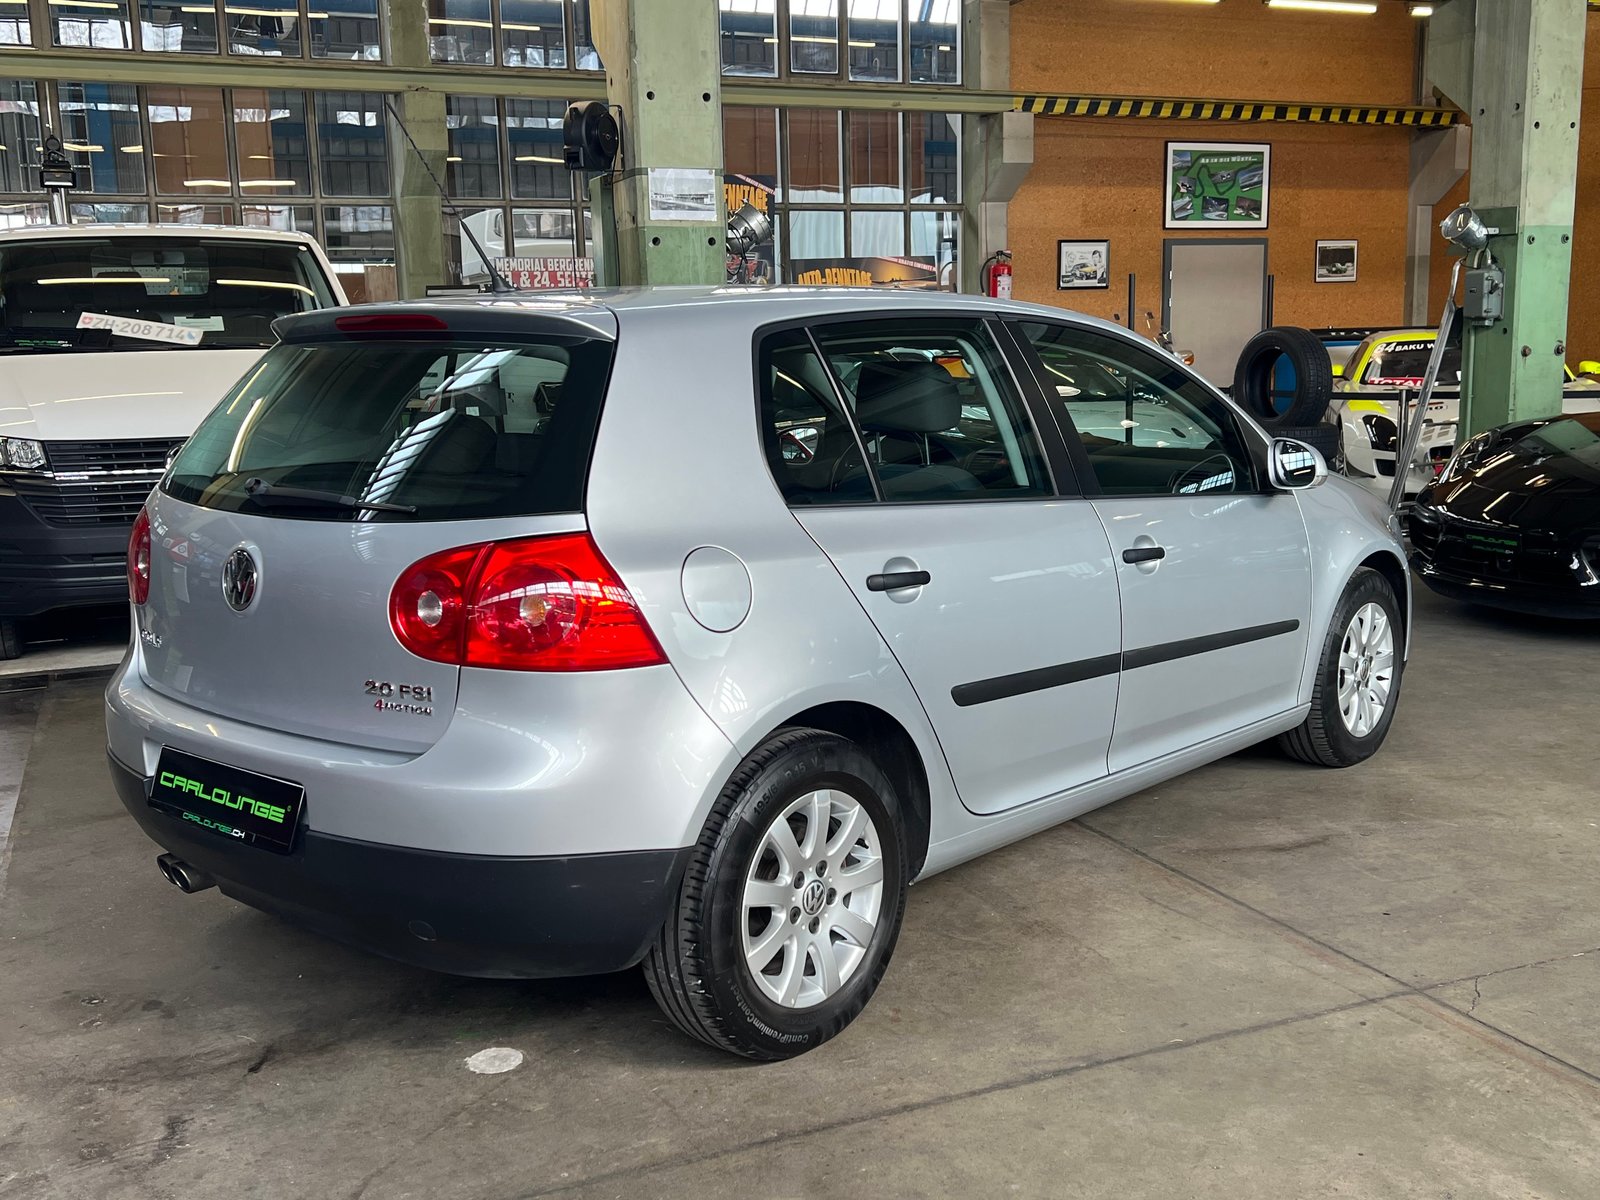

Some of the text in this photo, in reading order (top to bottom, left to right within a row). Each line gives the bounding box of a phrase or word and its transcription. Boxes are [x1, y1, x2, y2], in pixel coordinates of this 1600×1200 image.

[495, 258, 546, 272] MEMORIAL
[519, 271, 531, 288] &
[533, 271, 555, 288] 24.
[1395, 343, 1424, 352] BAKU
[399, 683, 433, 702] FSI
[374, 699, 433, 717] 4MOTION
[160, 771, 286, 824] CARLOUNGE
